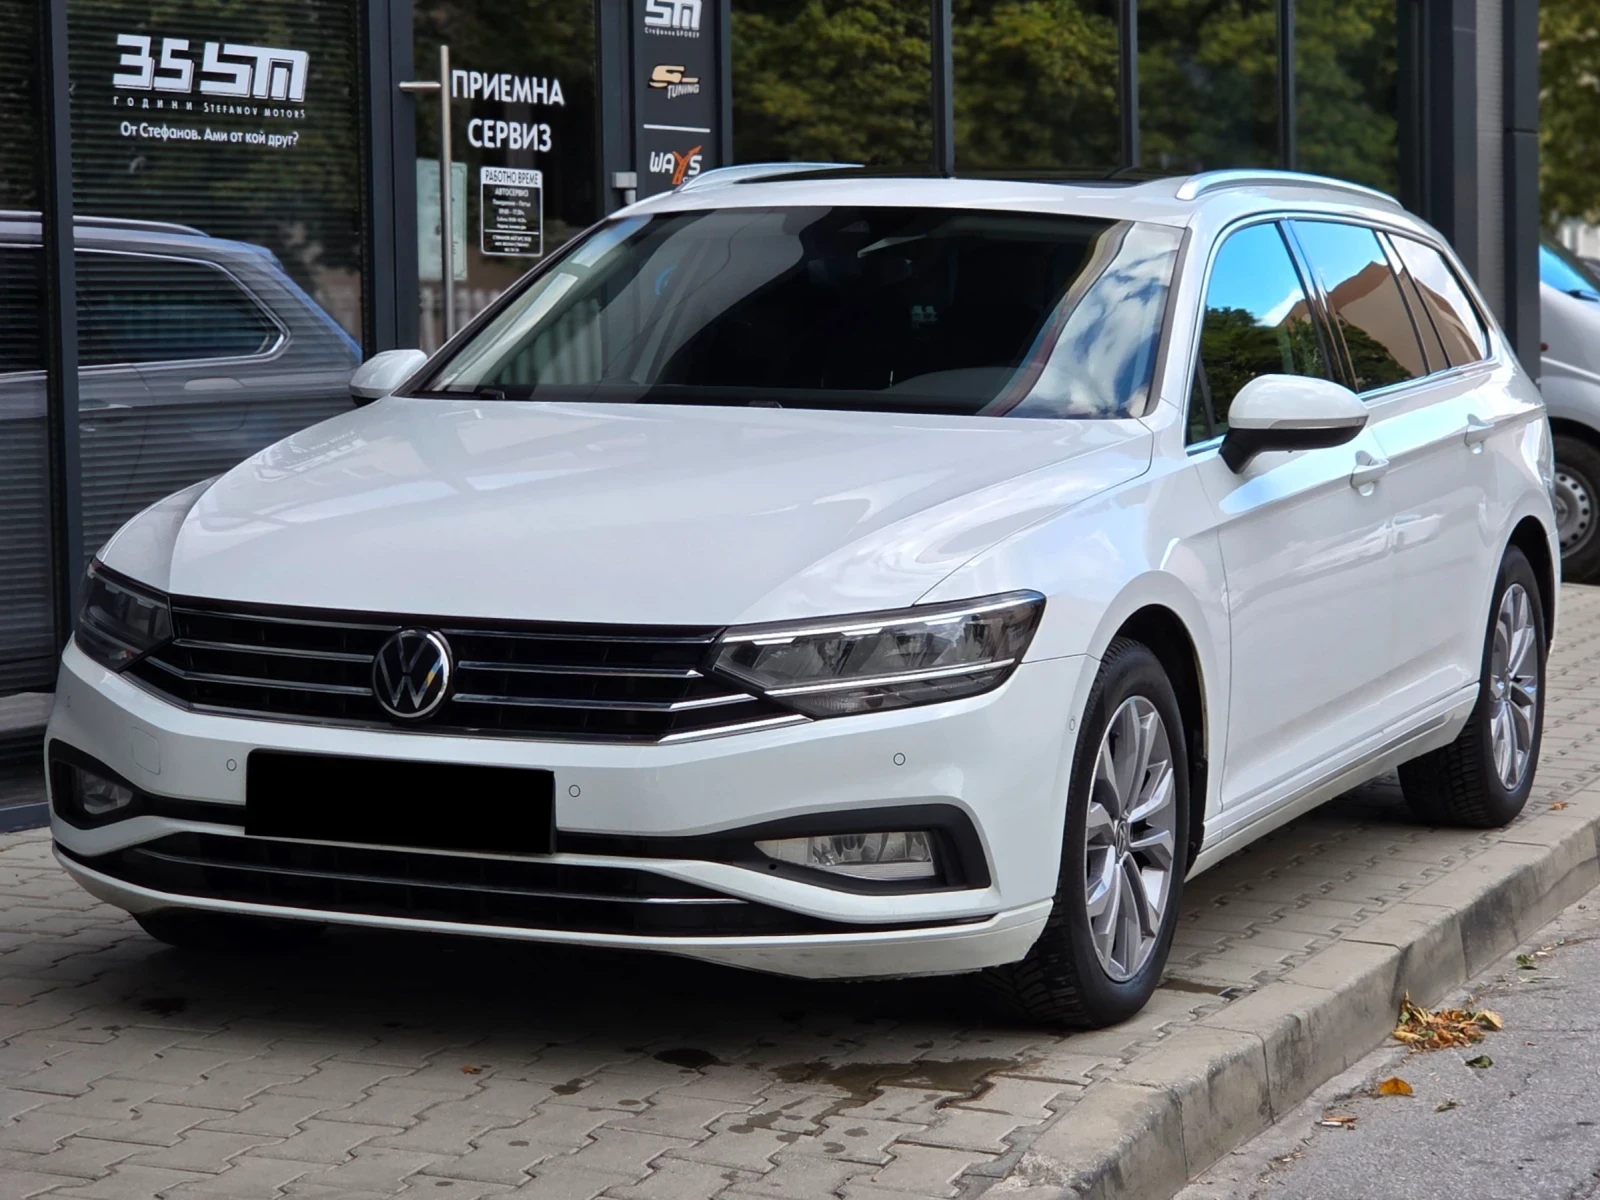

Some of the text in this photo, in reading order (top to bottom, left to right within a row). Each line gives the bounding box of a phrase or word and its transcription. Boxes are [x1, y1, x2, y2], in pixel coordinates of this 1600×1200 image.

[113, 33, 194, 93] 35
[452, 69, 565, 106] ПРИЕМНА
[667, 83, 700, 99] TUNING
[113, 96, 193, 111] ГОДИНИ
[264, 108, 306, 119] MOTORS
[120, 121, 299, 148] От Стефанов. Ами от кой друг?
[467, 118, 552, 152] СЕРВИЗ
[485, 169, 539, 185] РАБОТНО ВРЕМЕ
[649, 145, 702, 185] WAYS
